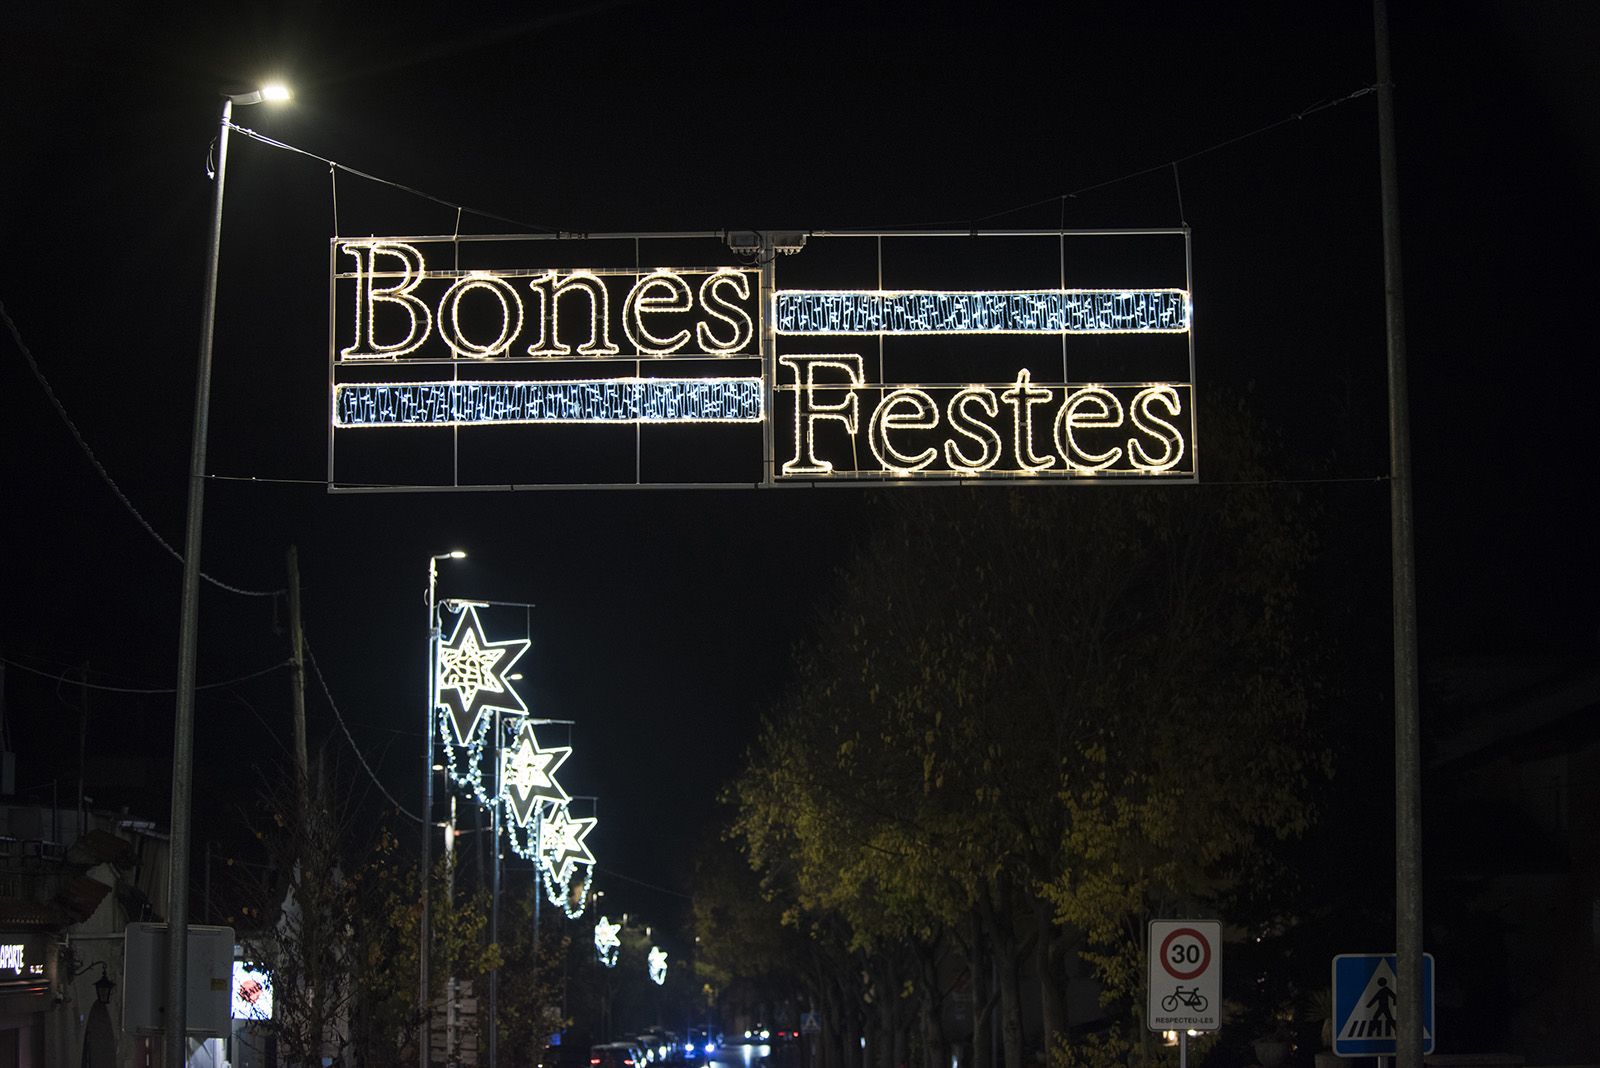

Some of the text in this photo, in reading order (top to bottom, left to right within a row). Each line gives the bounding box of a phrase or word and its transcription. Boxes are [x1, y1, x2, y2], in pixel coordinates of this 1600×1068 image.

[341, 242, 753, 360] Bones
[779, 353, 1185, 474] Festes
[1171, 944, 1200, 964] 30
